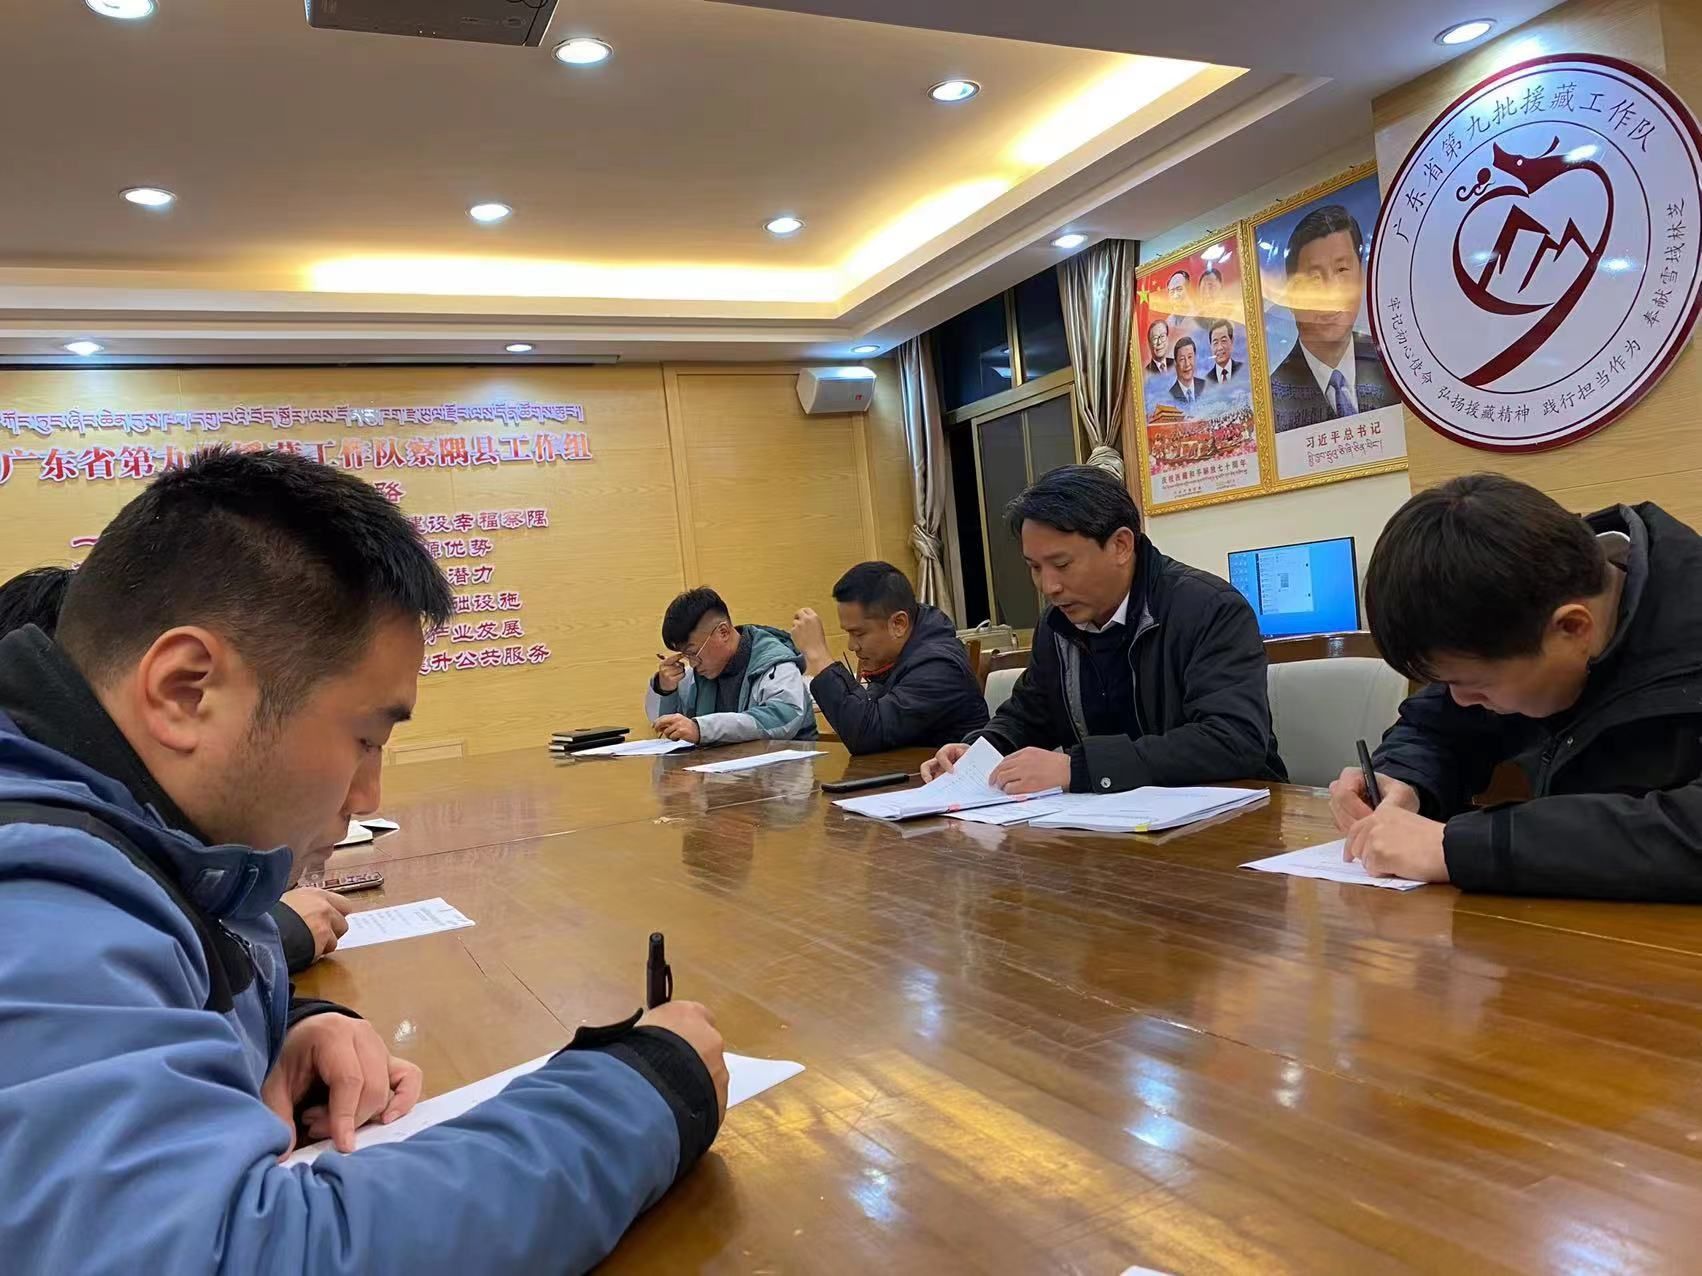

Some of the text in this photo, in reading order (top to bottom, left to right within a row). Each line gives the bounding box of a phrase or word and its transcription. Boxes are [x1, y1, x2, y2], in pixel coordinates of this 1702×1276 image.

[1392, 82, 1657, 244] 广东省第九批援藏工作队
[1387, 198, 1686, 423] 牢记初心使命 弘扬援藏精神 践行担当作为 奉献雪域林芝
[1306, 421, 1381, 448] 习近平总书记
[448, 566, 494, 584] 潜力
